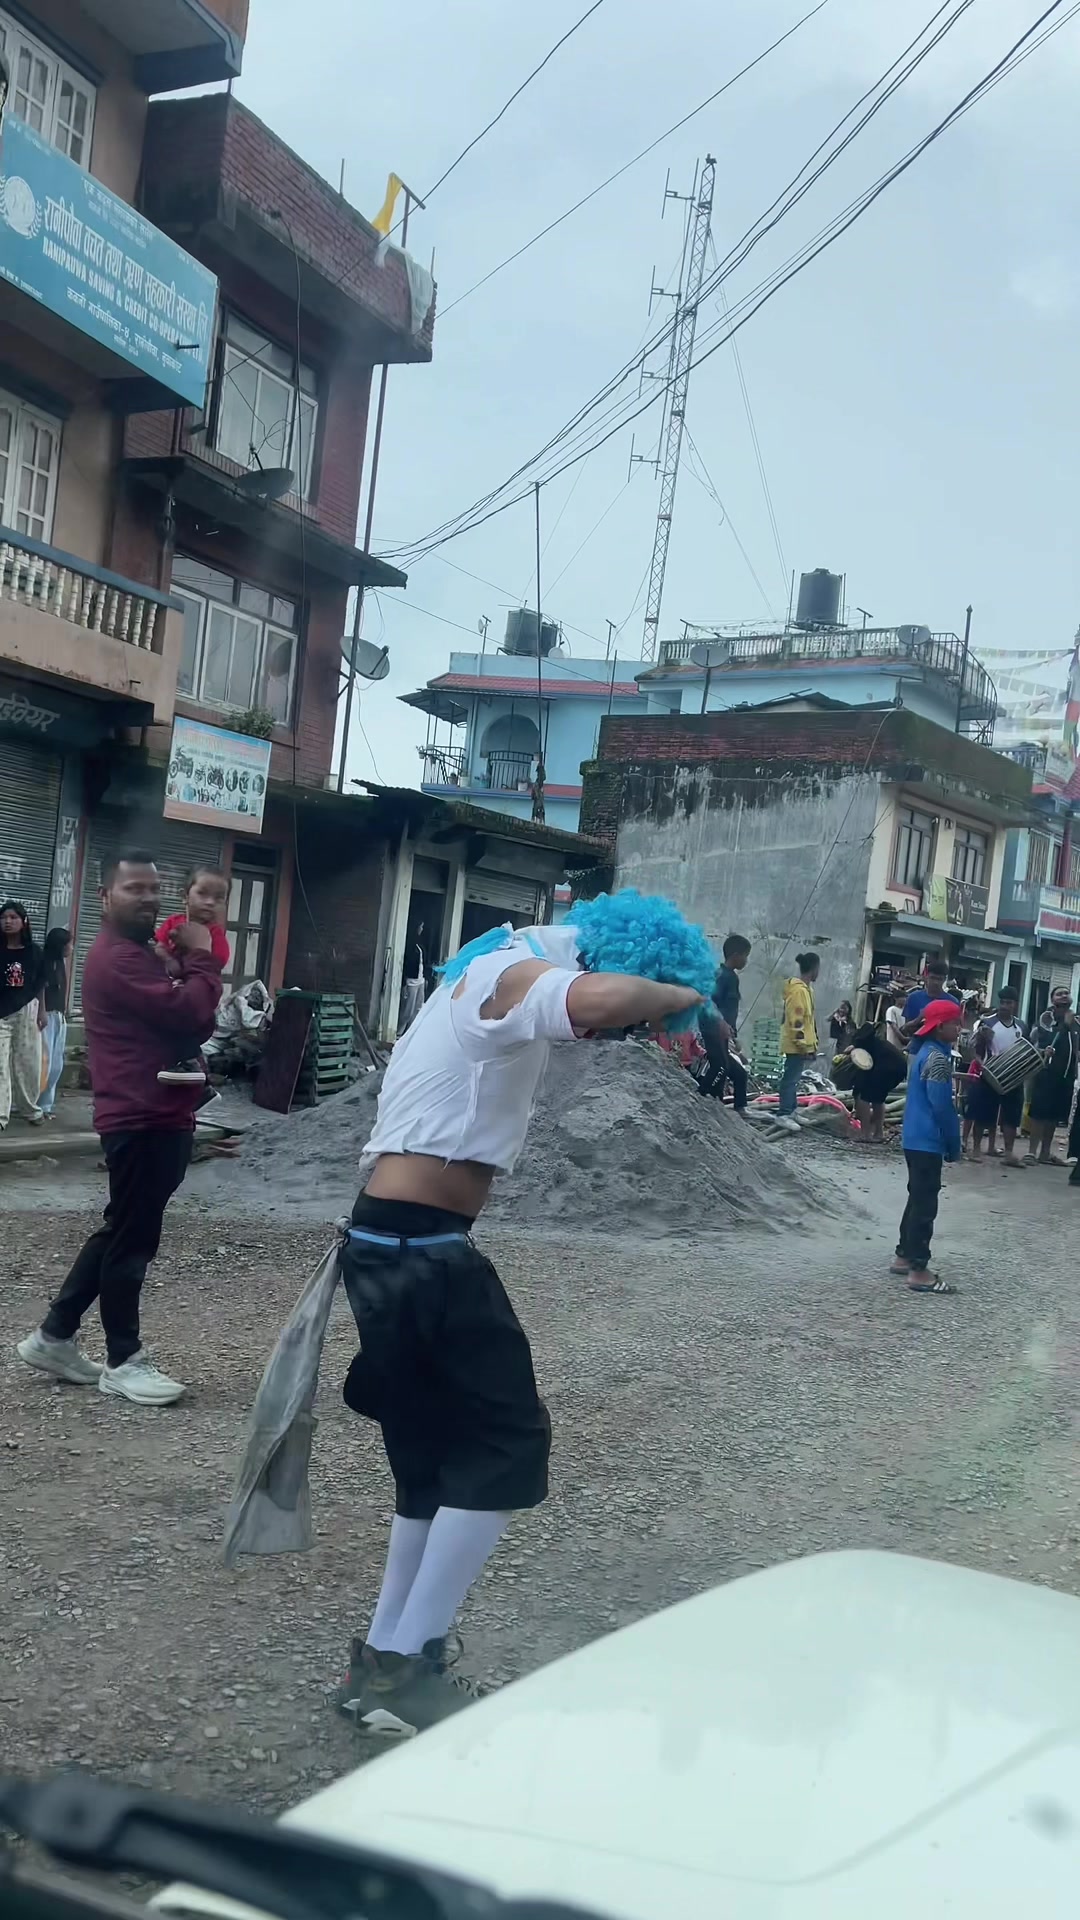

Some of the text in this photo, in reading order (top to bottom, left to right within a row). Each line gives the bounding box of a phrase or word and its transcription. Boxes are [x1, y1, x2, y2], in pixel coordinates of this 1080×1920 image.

[88, 269, 114, 302] SAVING
[115, 289, 122, 308] &
[124, 295, 148, 325] CREDIT
[105, 241, 124, 280] तथा
[145, 271, 176, 319] सहकारी
[176, 292, 198, 334] संस्था
